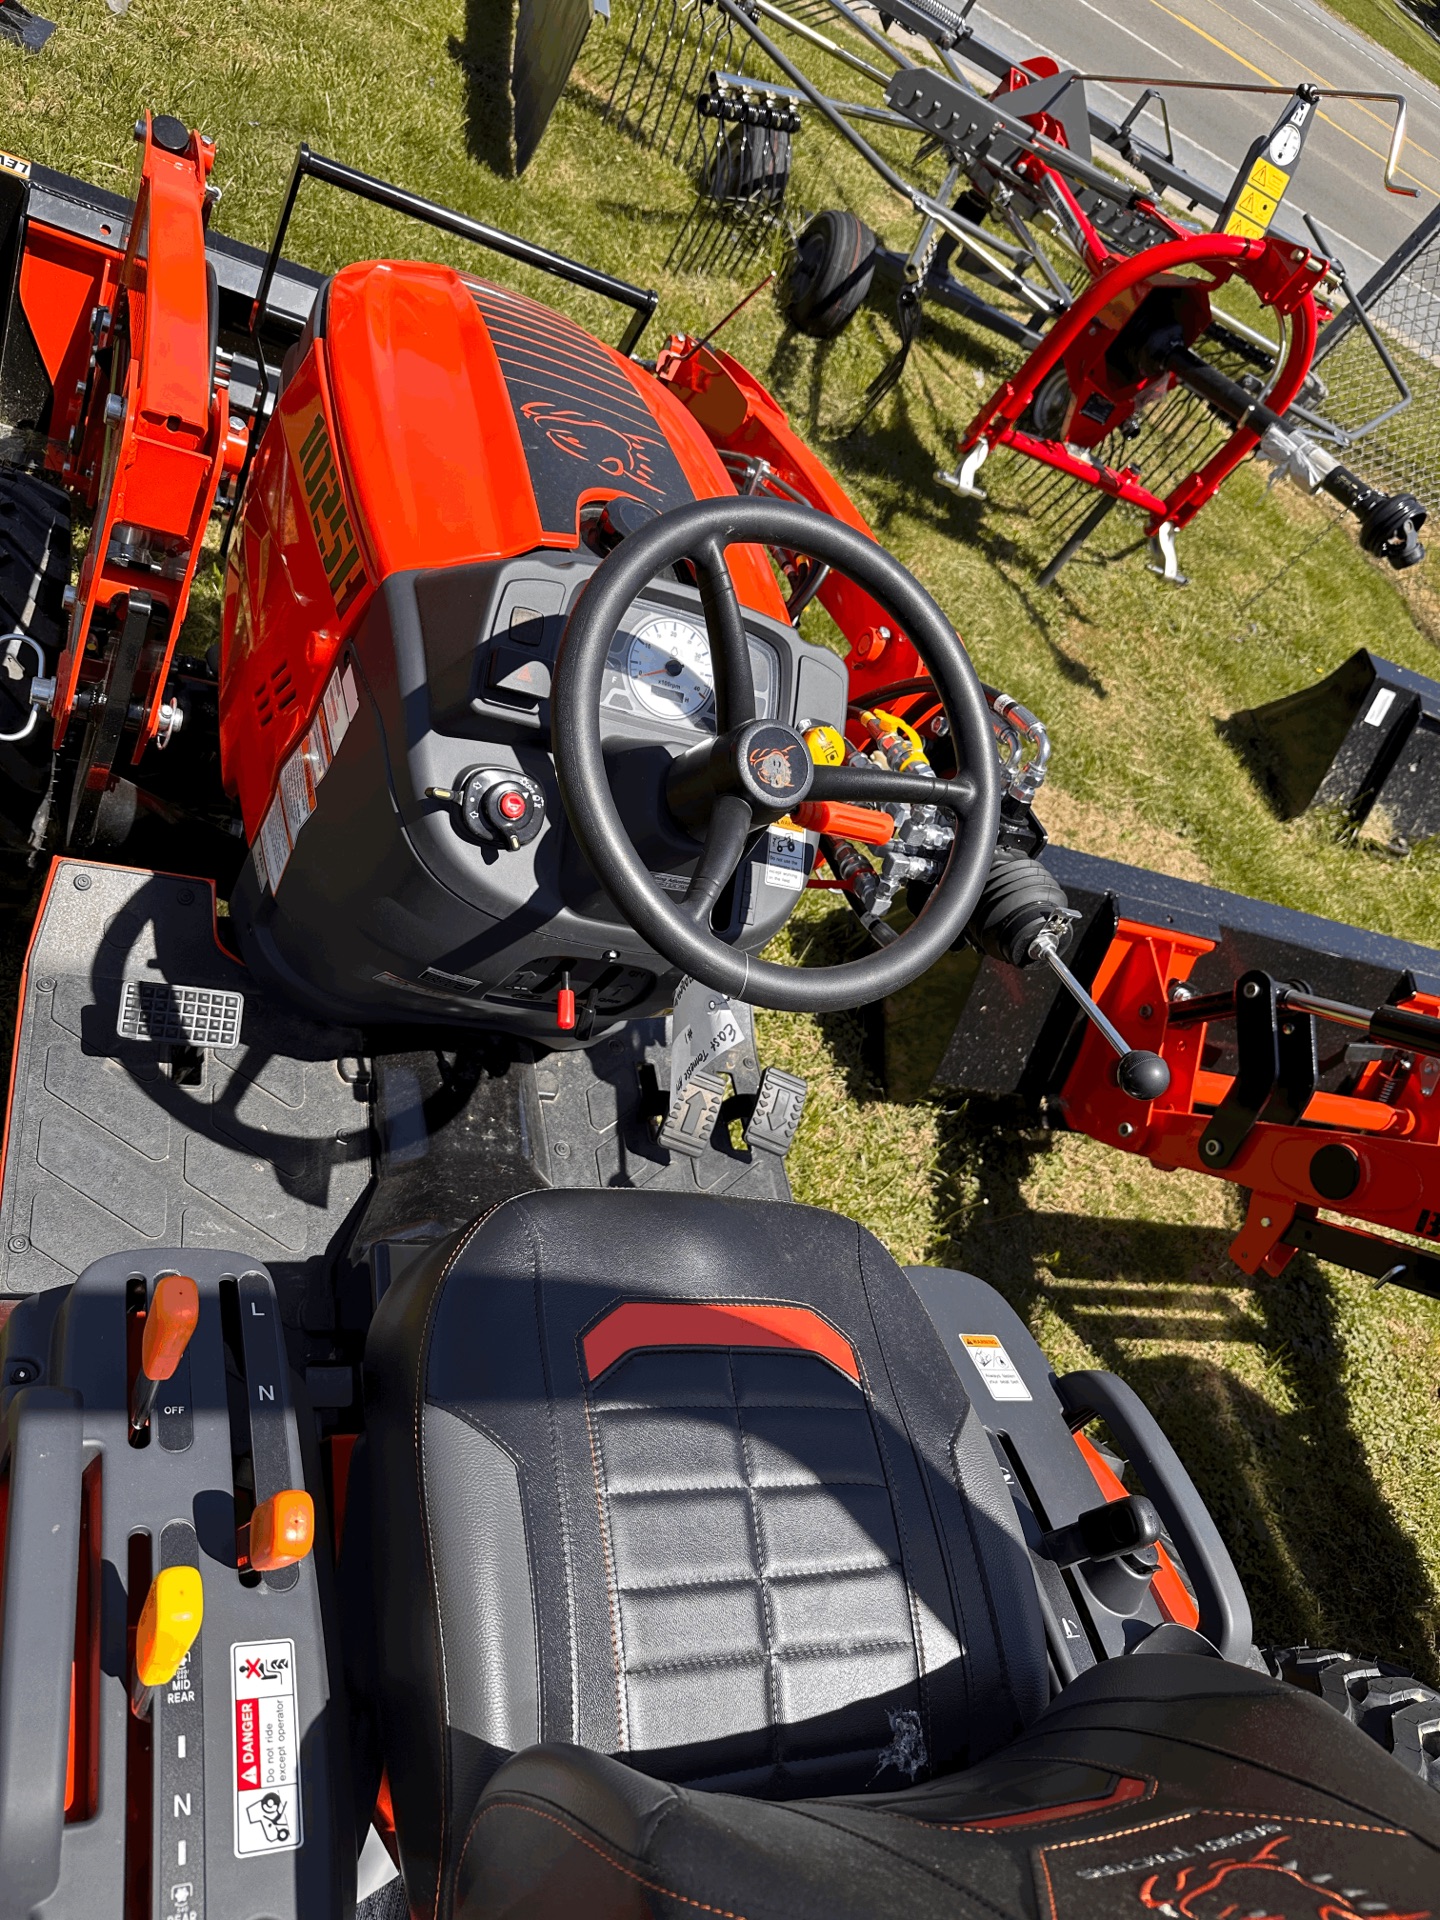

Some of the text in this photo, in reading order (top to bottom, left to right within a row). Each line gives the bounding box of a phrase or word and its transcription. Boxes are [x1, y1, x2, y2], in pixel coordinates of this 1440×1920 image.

[299, 412, 368, 622] 1025H
[711, 1023, 737, 1052] East
[251, 1302, 265, 1316] L
[258, 1385, 275, 1401] N
[164, 1406, 185, 1415] OFF
[167, 1691, 195, 1704] REAR
[172, 1679, 191, 1691] MID
[242, 1702, 254, 1764] DANGER
[277, 1699, 287, 1782] except operator
[266, 1723, 275, 1783] Do not ride
[174, 1793, 191, 1818] N
